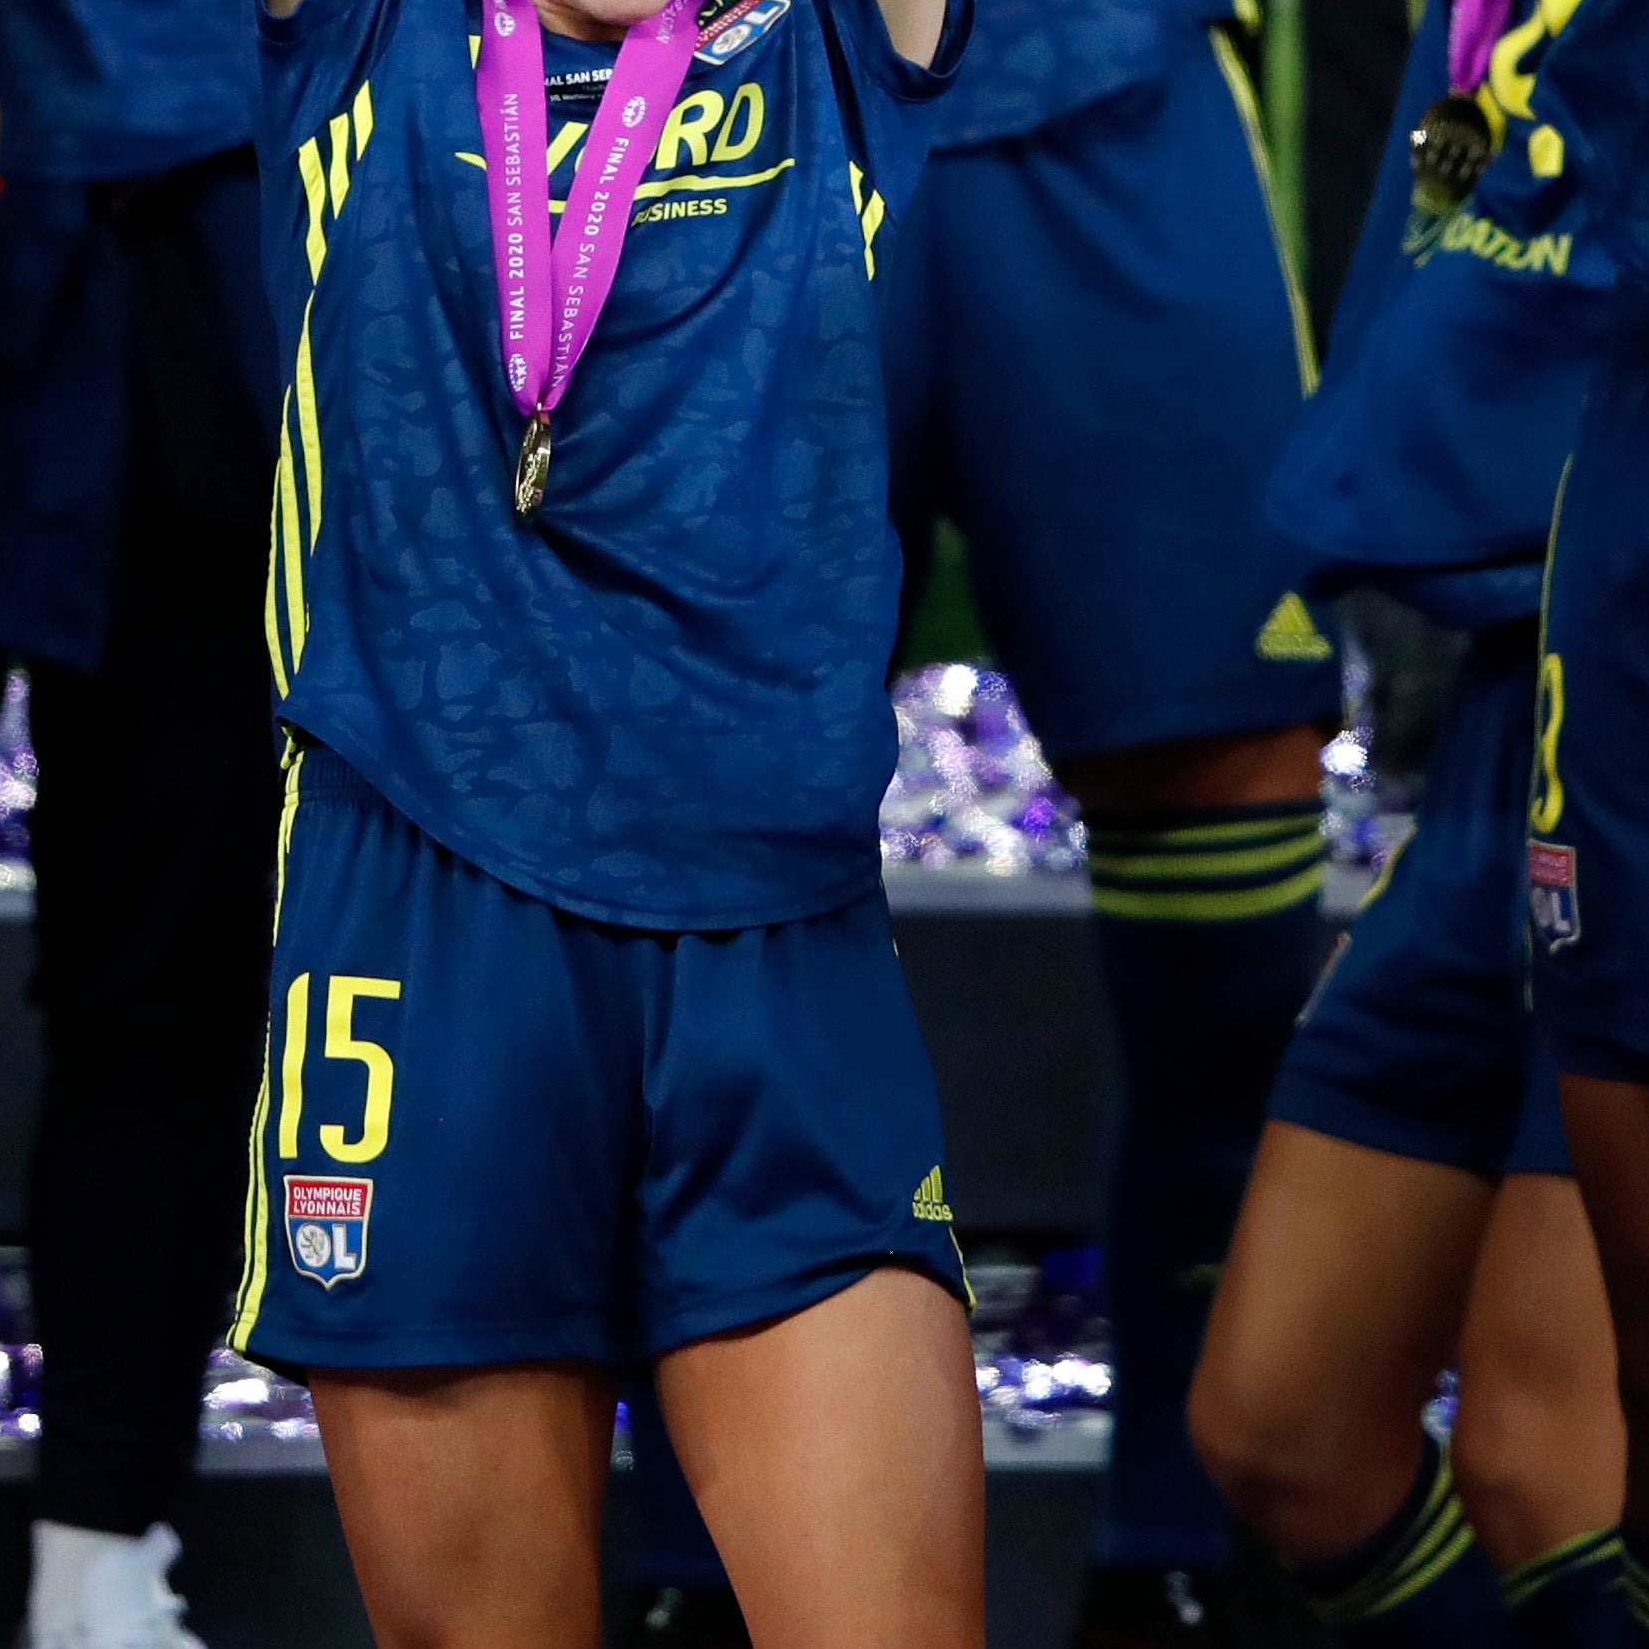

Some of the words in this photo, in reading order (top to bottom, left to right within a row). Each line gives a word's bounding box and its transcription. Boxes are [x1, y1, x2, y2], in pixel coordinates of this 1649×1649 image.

[500, 93, 522, 187] SEBASTIÁN
[599, 136, 630, 185] FINAL
[506, 191, 523, 227] SAN
[583, 191, 610, 237] 2020
[507, 232, 524, 280] 2020
[572, 242, 596, 279] SAN
[509, 286, 525, 341] FINAL
[279, 971, 402, 1164] 15
[293, 1186, 363, 1201] OLYMPIQUE
[293, 1200, 362, 1216] LYONNAIS
[295, 1222, 357, 1271] OL
